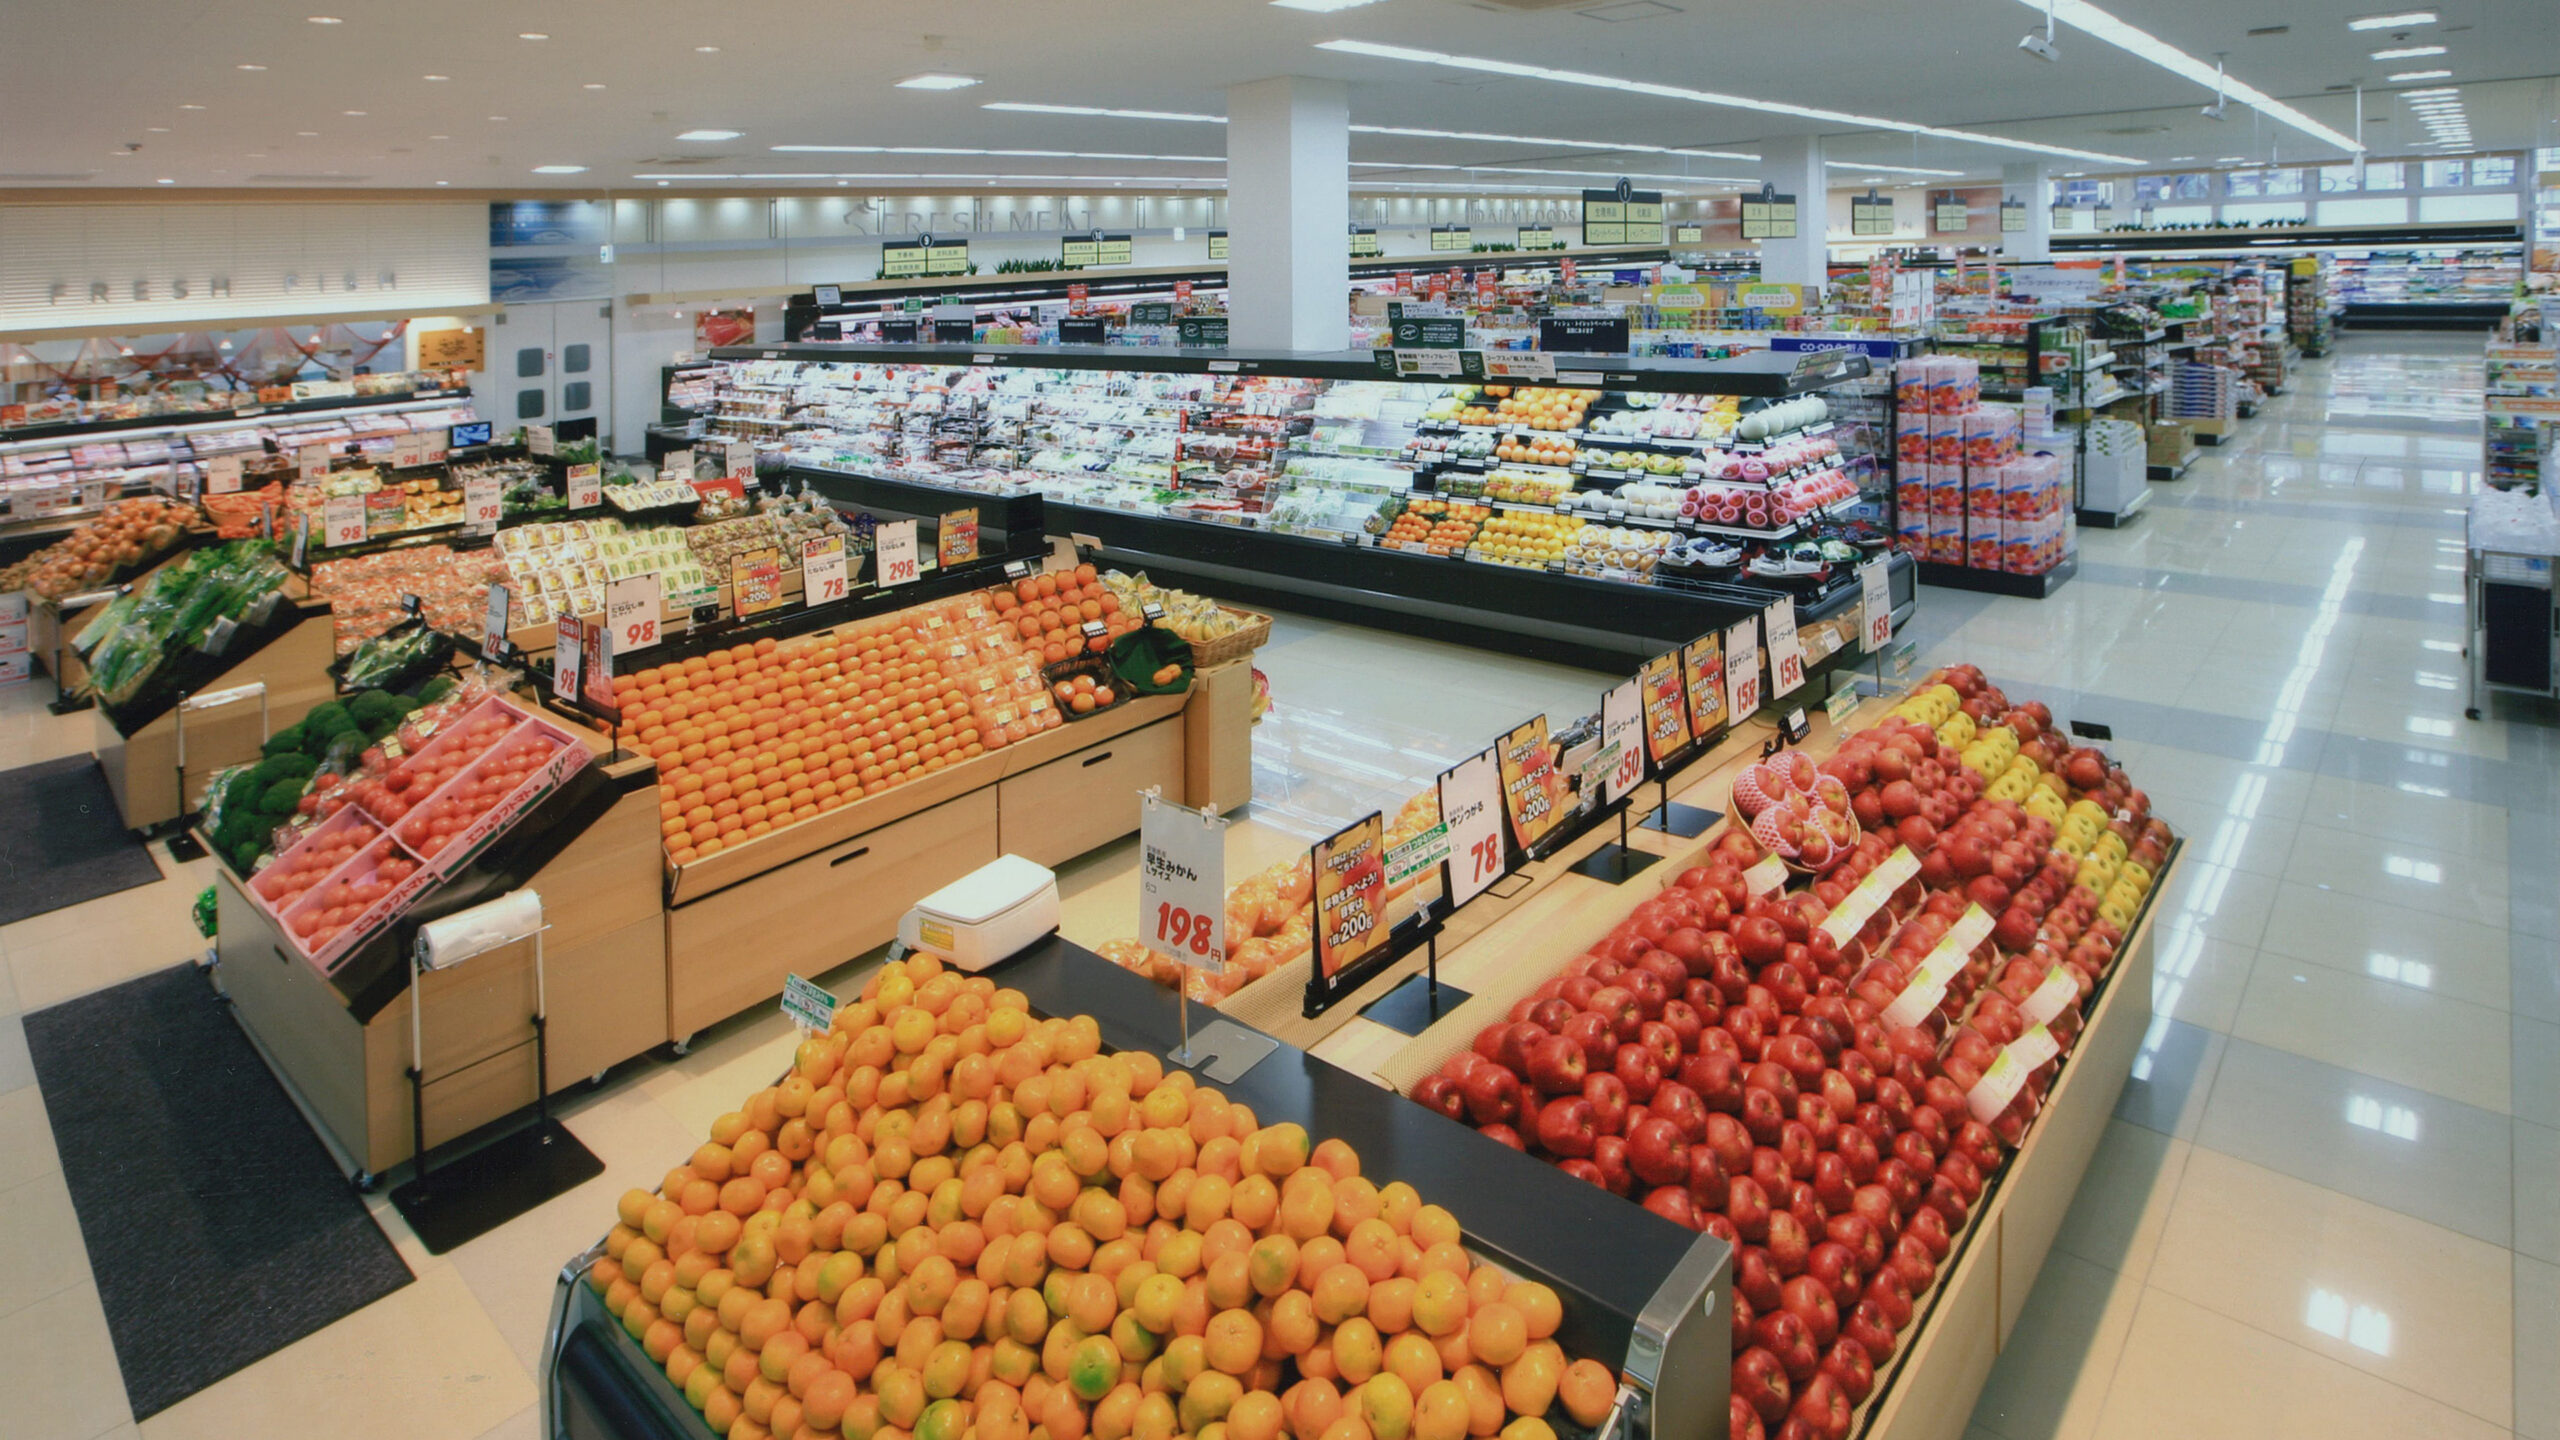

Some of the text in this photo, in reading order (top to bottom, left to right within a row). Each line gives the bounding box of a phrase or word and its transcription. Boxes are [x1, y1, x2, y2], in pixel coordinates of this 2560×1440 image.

[882, 210, 1098, 234] FRESH MEAT
[49, 272, 397, 306] FRESH FISH
[582, 491, 598, 505] 98
[479, 505, 498, 520] 98
[341, 525, 361, 542] 98
[889, 559, 914, 580] 298
[824, 577, 844, 598] 78
[627, 620, 656, 646] 98
[1873, 614, 1889, 644] 158
[561, 668, 575, 694] 98
[1780, 654, 1798, 688] 158
[1737, 677, 1757, 714] 158
[1450, 801, 1484, 828] サンつがる
[1146, 851, 1198, 882] 早生みかん
[1471, 833, 1497, 883] 78
[1146, 864, 1171, 882] Lサイズ
[1323, 871, 1378, 911] 果物を食べよう!
[1157, 901, 1213, 955] 198
